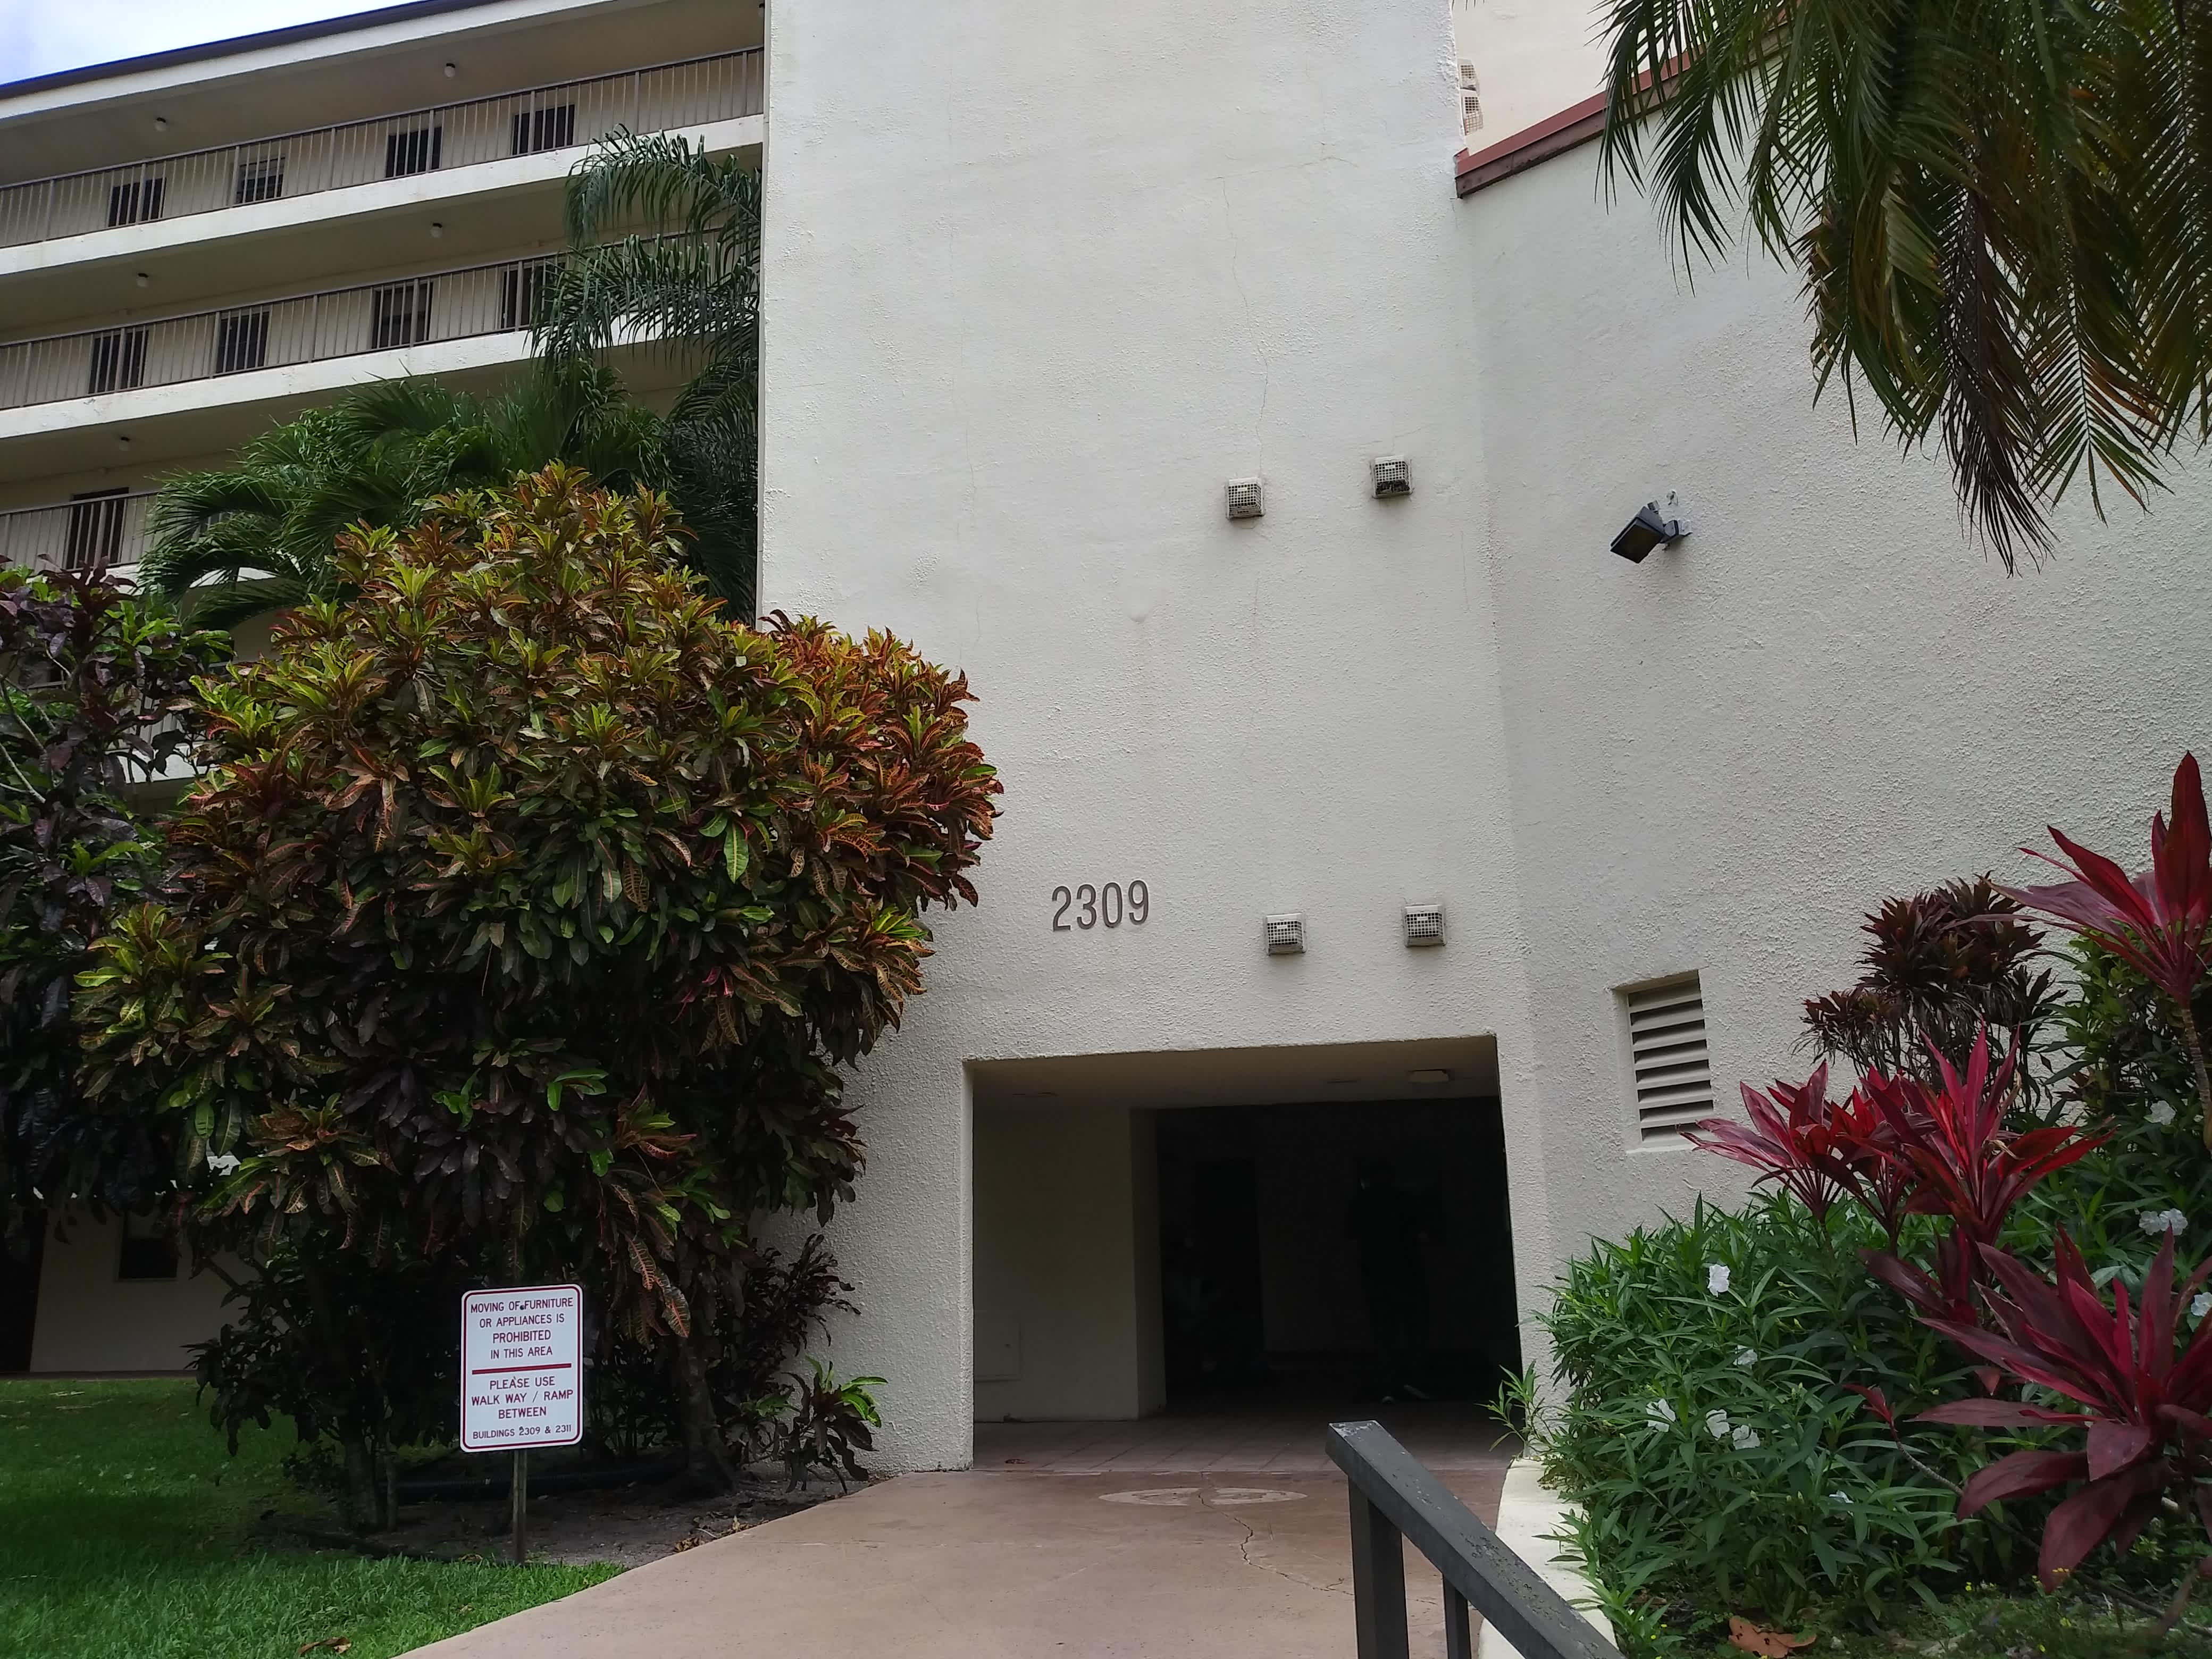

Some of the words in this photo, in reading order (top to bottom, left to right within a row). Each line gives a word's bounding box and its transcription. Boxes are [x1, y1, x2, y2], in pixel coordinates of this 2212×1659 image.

[1052, 880, 1149, 932] 2309
[471, 1302, 504, 1313] MOVING
[509, 1301, 520, 1310] OF
[524, 1298, 573, 1308] FURNITURE
[480, 1318, 491, 1328] OR
[497, 1314, 552, 1326] APPLIANCES
[556, 1313, 564, 1323] IS
[493, 1330, 551, 1343] PROHIBITED
[491, 1350, 499, 1359] IN
[504, 1348, 523, 1358] THIS
[527, 1346, 552, 1356] AREA
[490, 1378, 530, 1390] PLEASE
[535, 1377, 555, 1387] USE
[472, 1395, 500, 1405] WALK
[506, 1393, 527, 1403] WAY
[532, 1392, 538, 1402] /
[543, 1390, 573, 1401] RAMP
[498, 1407, 547, 1419] BETWEEN
[473, 1429, 515, 1439] BUILDINGS
[519, 1427, 540, 1436] 2309
